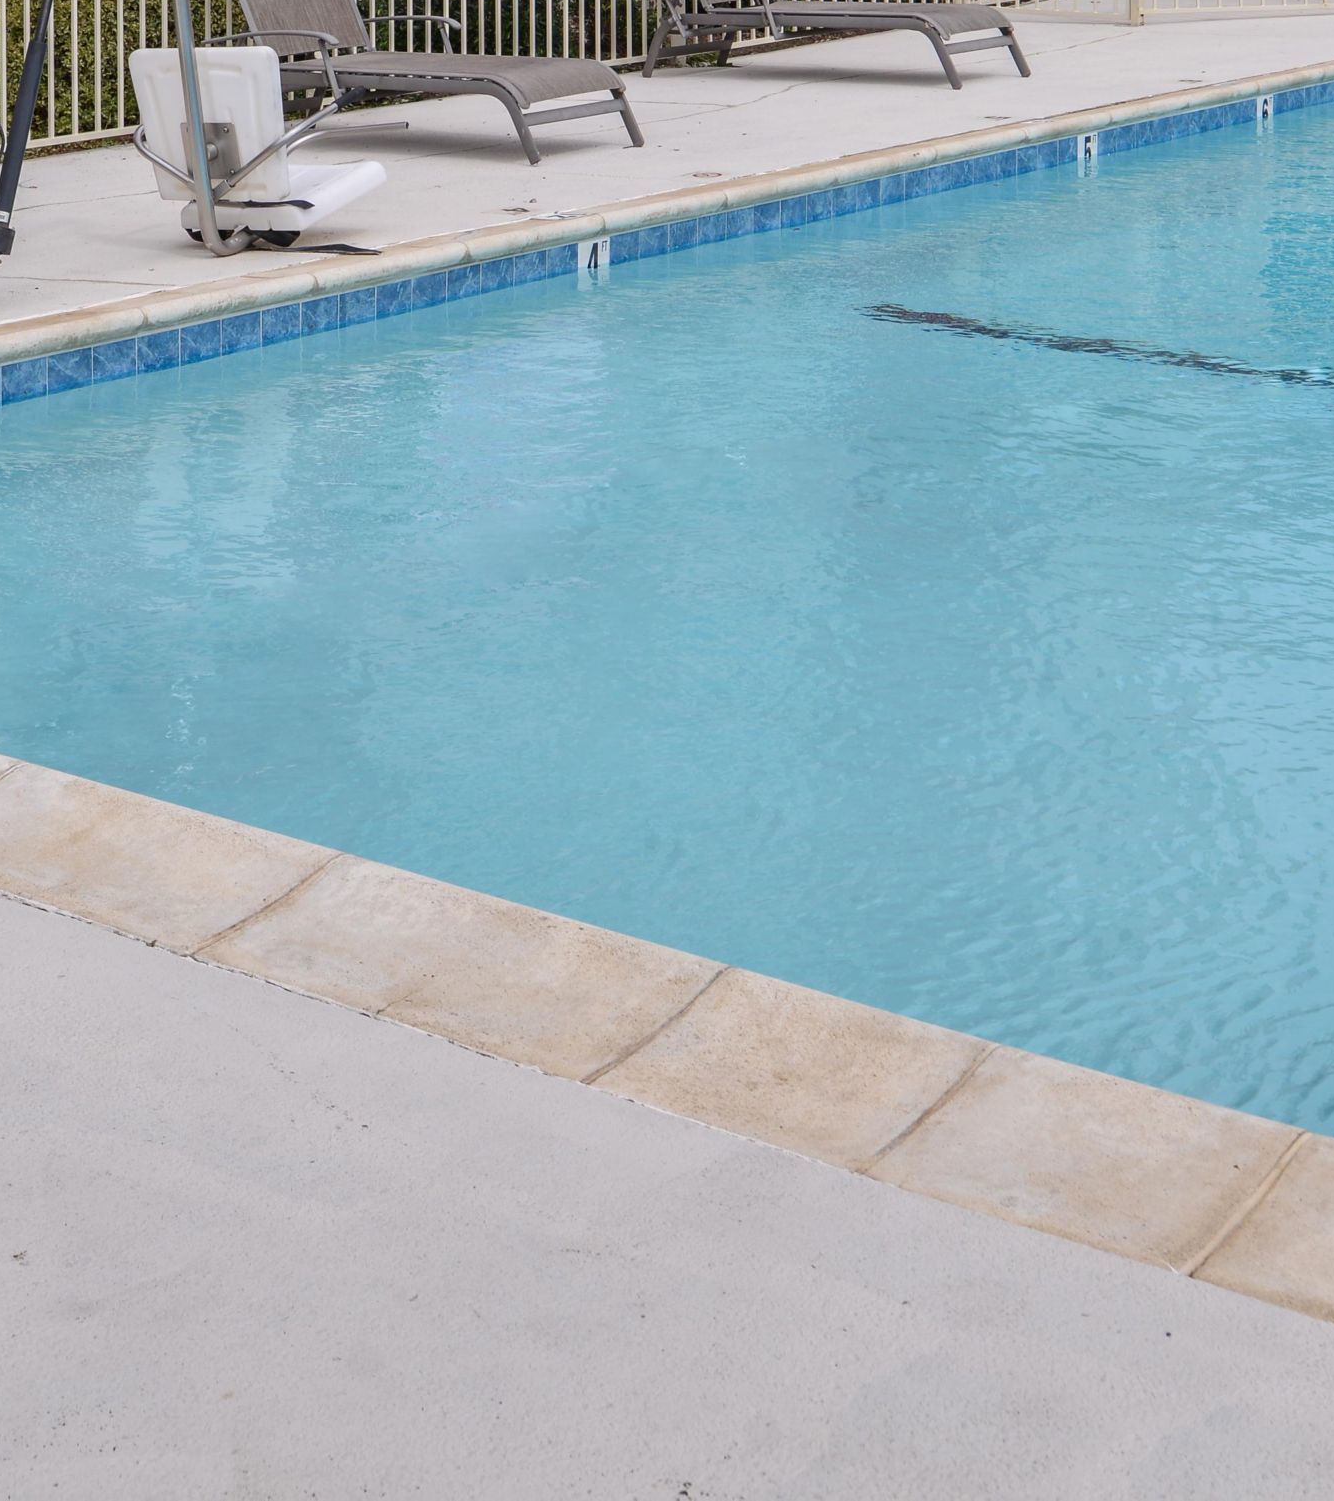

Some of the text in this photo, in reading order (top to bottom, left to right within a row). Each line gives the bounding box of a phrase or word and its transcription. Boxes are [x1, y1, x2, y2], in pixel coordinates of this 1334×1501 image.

[1084, 135, 1091, 158] 5
[587, 240, 608, 269] 4 FT
